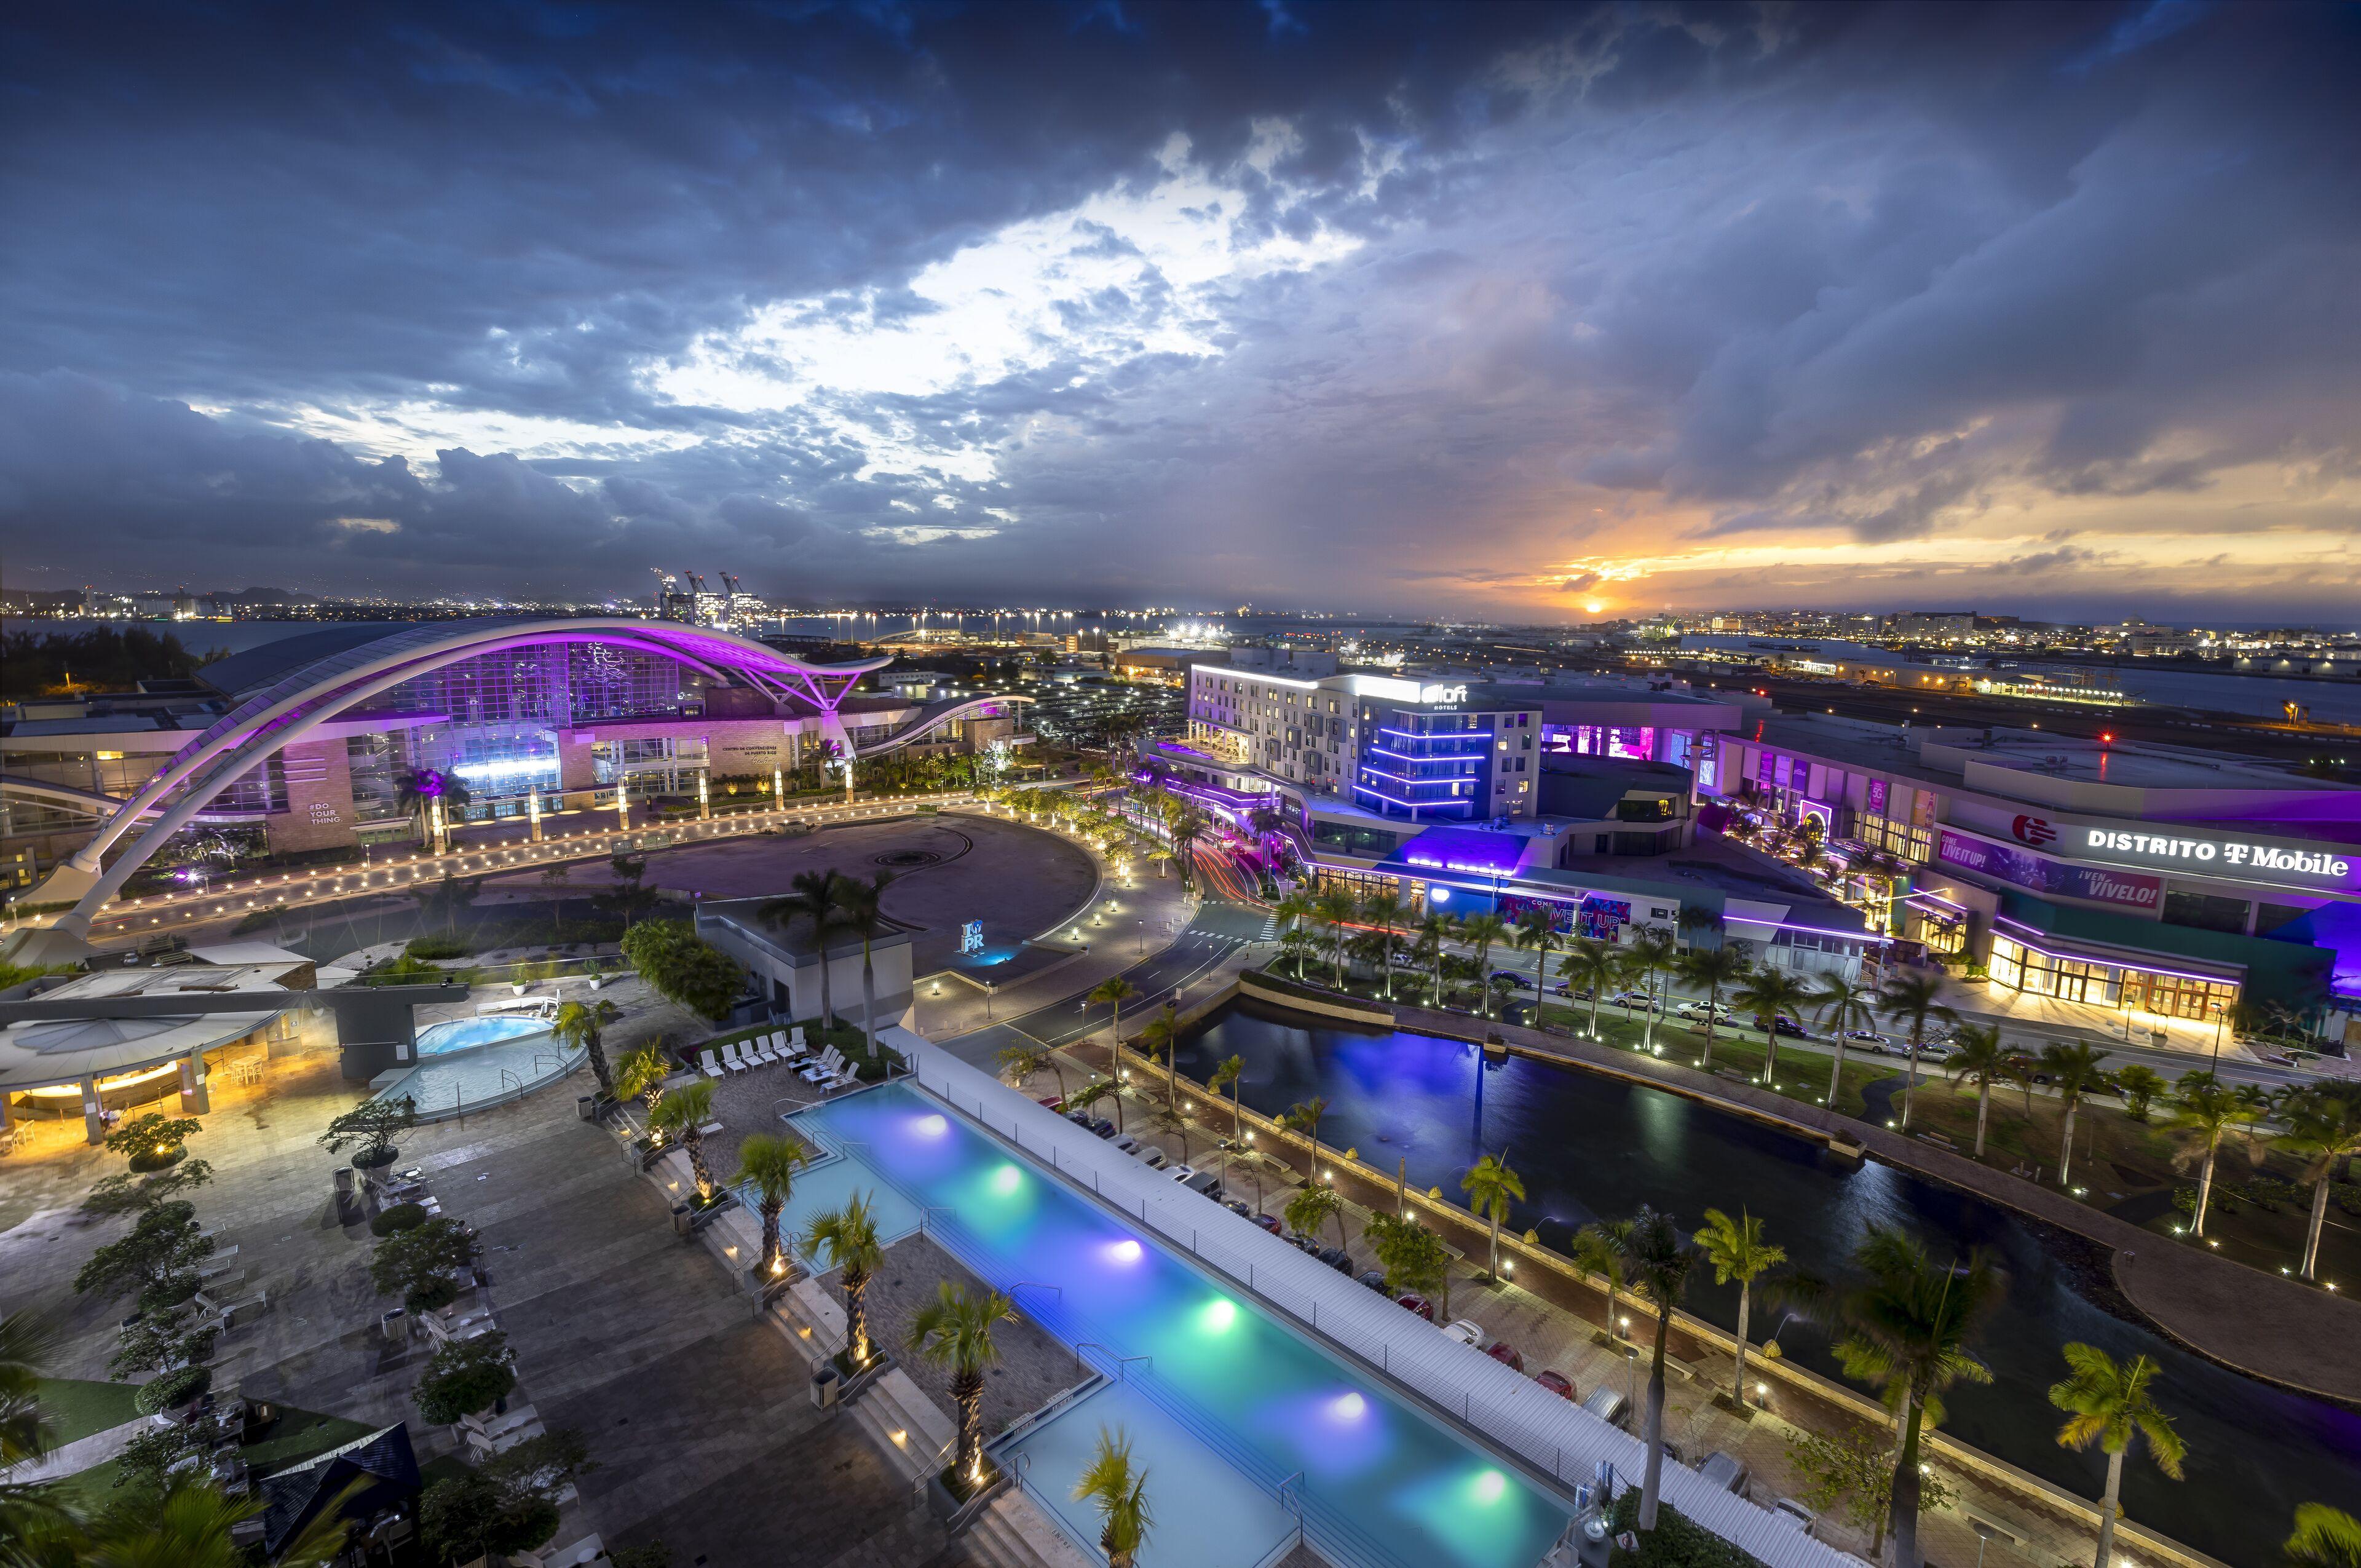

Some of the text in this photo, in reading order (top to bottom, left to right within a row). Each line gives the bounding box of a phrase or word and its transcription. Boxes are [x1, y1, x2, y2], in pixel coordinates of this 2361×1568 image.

[1872, 787, 1883, 799] 5G
[1942, 835, 1958, 845] COME
[2088, 830, 2216, 861] DISTRITO
[1942, 843, 1987, 868] LIVE IT UP!
[2090, 879, 2157, 903] VÍVELO!
[1578, 911, 1593, 925] IT
[963, 933, 984, 952] PR
